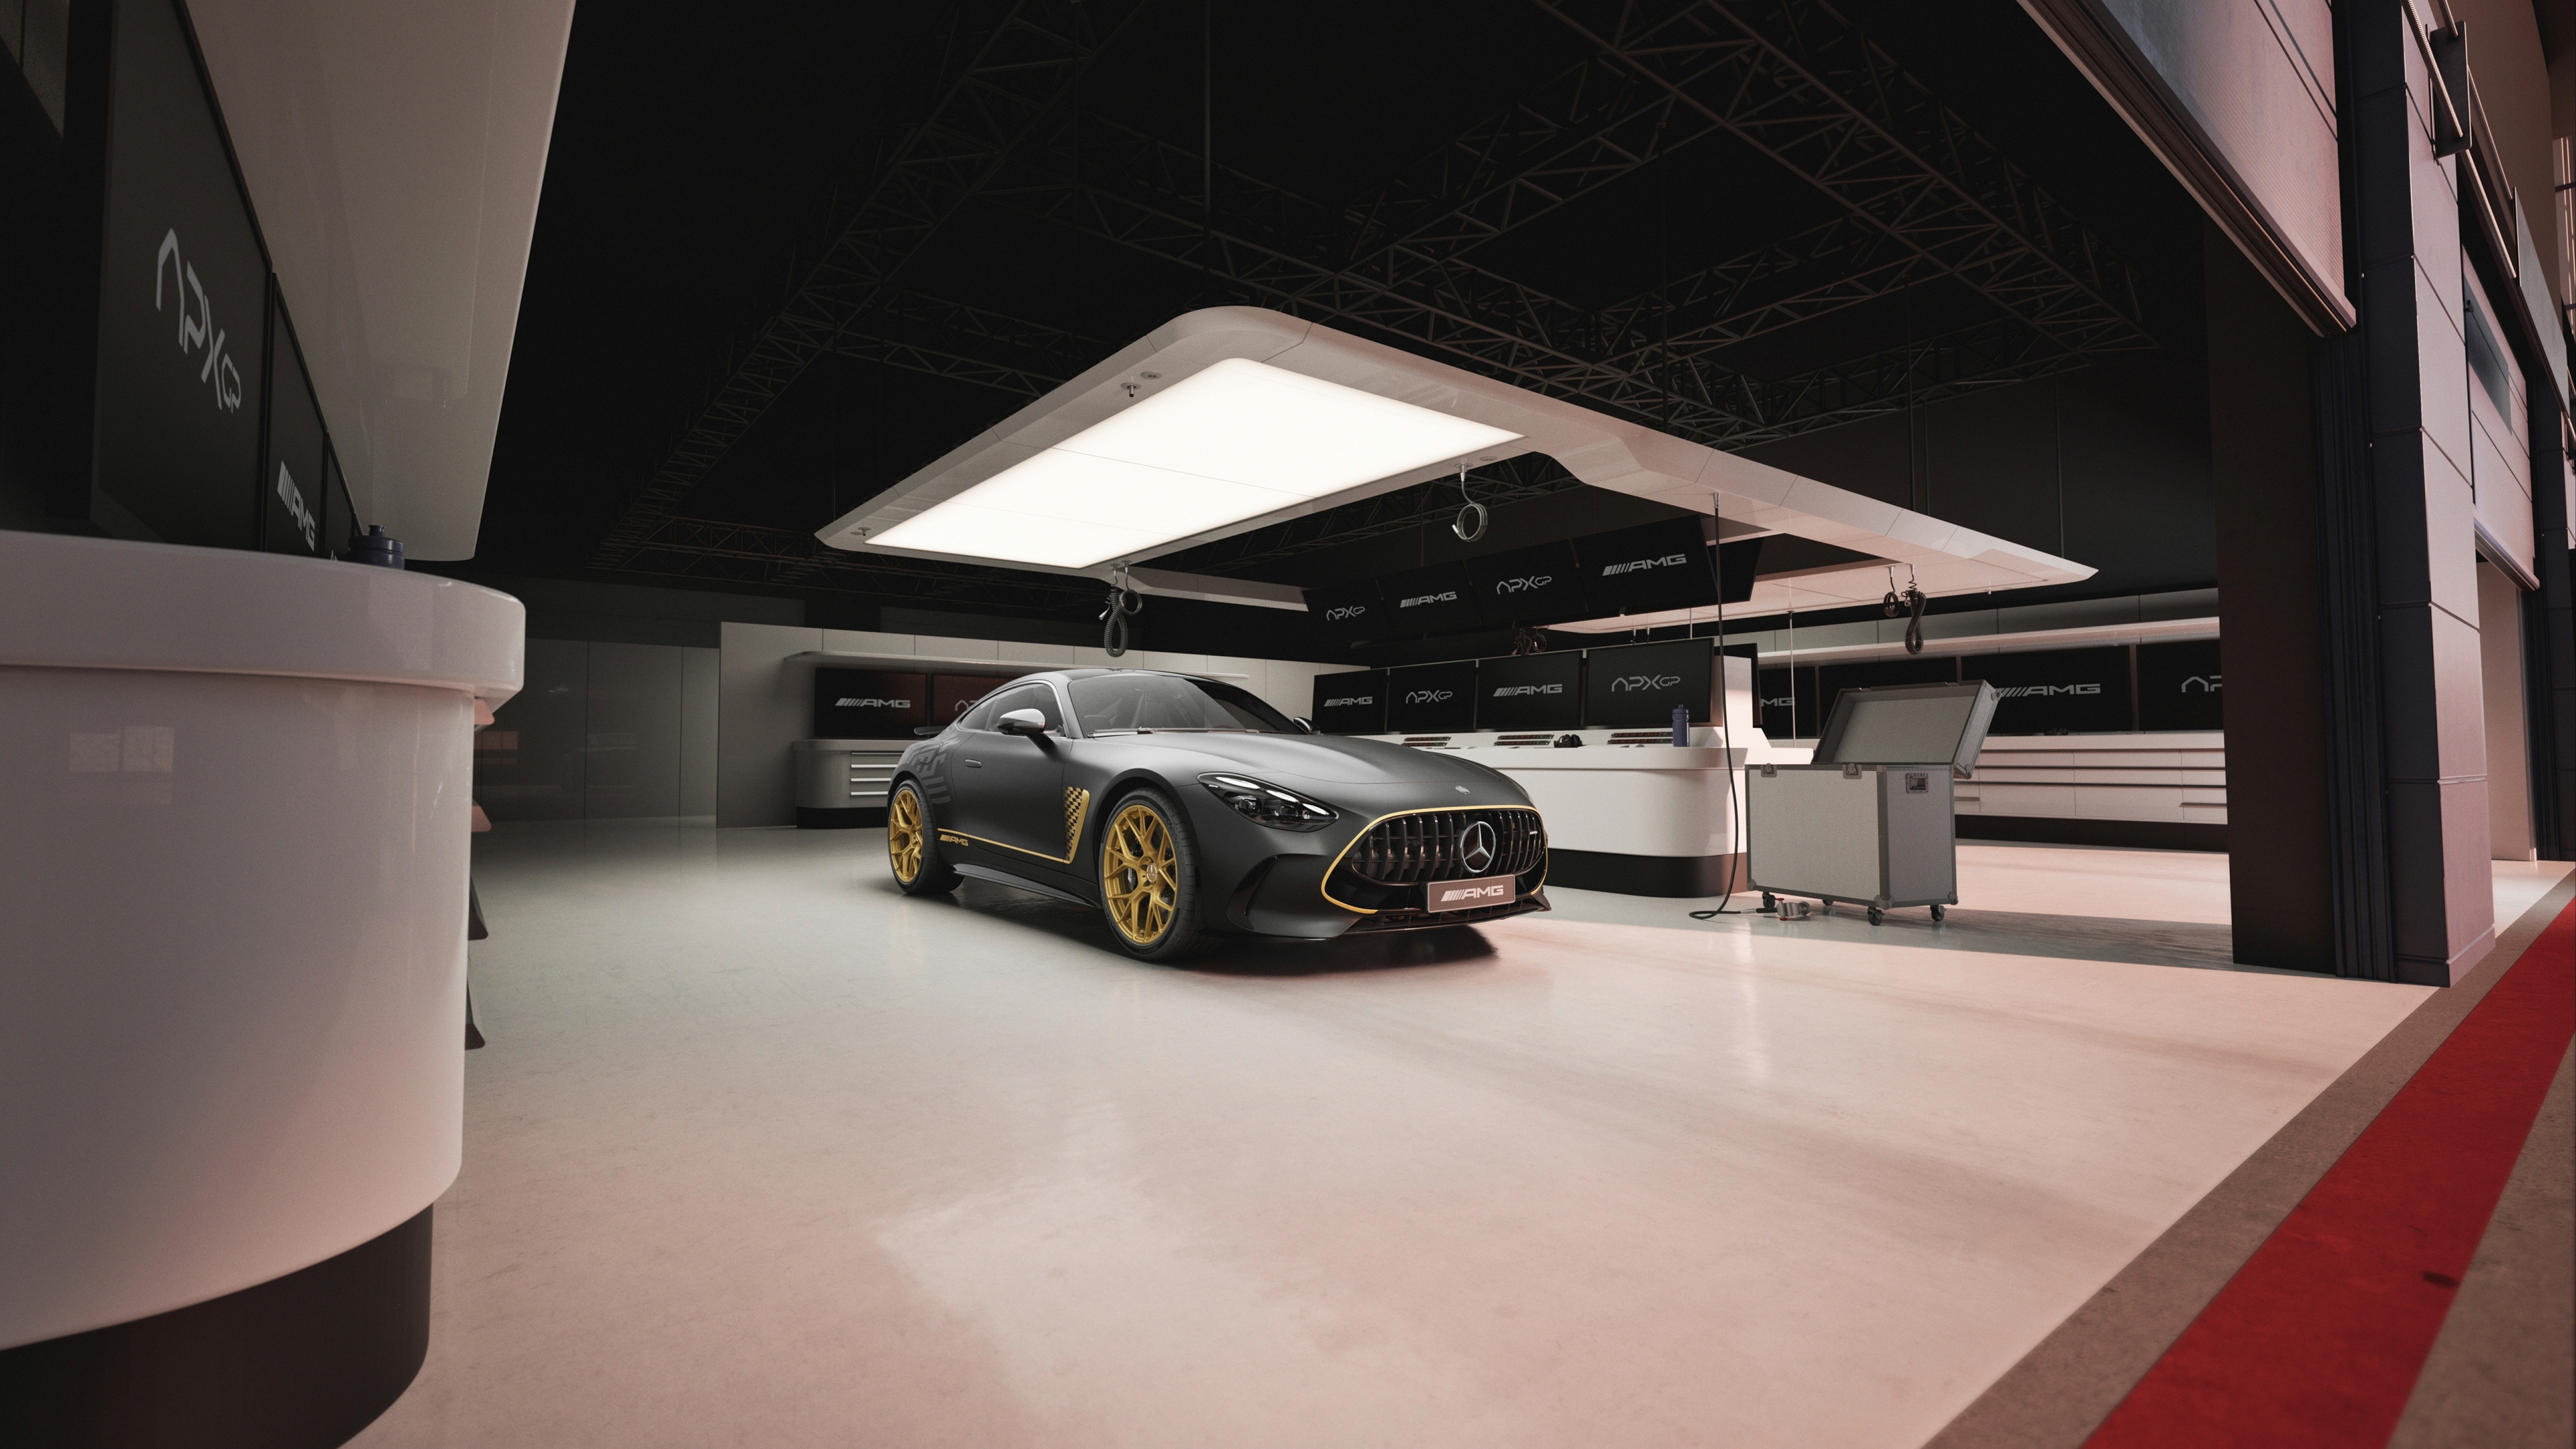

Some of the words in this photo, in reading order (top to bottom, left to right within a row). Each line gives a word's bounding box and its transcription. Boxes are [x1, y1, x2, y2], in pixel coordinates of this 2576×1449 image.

[291, 485, 315, 551] AMG
[1628, 553, 1686, 572] AMG
[1417, 591, 1458, 605] AMG
[1514, 684, 1563, 696] AMG
[2023, 683, 2101, 697] AMG
[859, 698, 911, 708] AMG
[1339, 696, 1373, 706] AMG
[1761, 697, 1795, 707] MG
[949, 836, 969, 847] AMG
[1461, 884, 1504, 900] AMG
